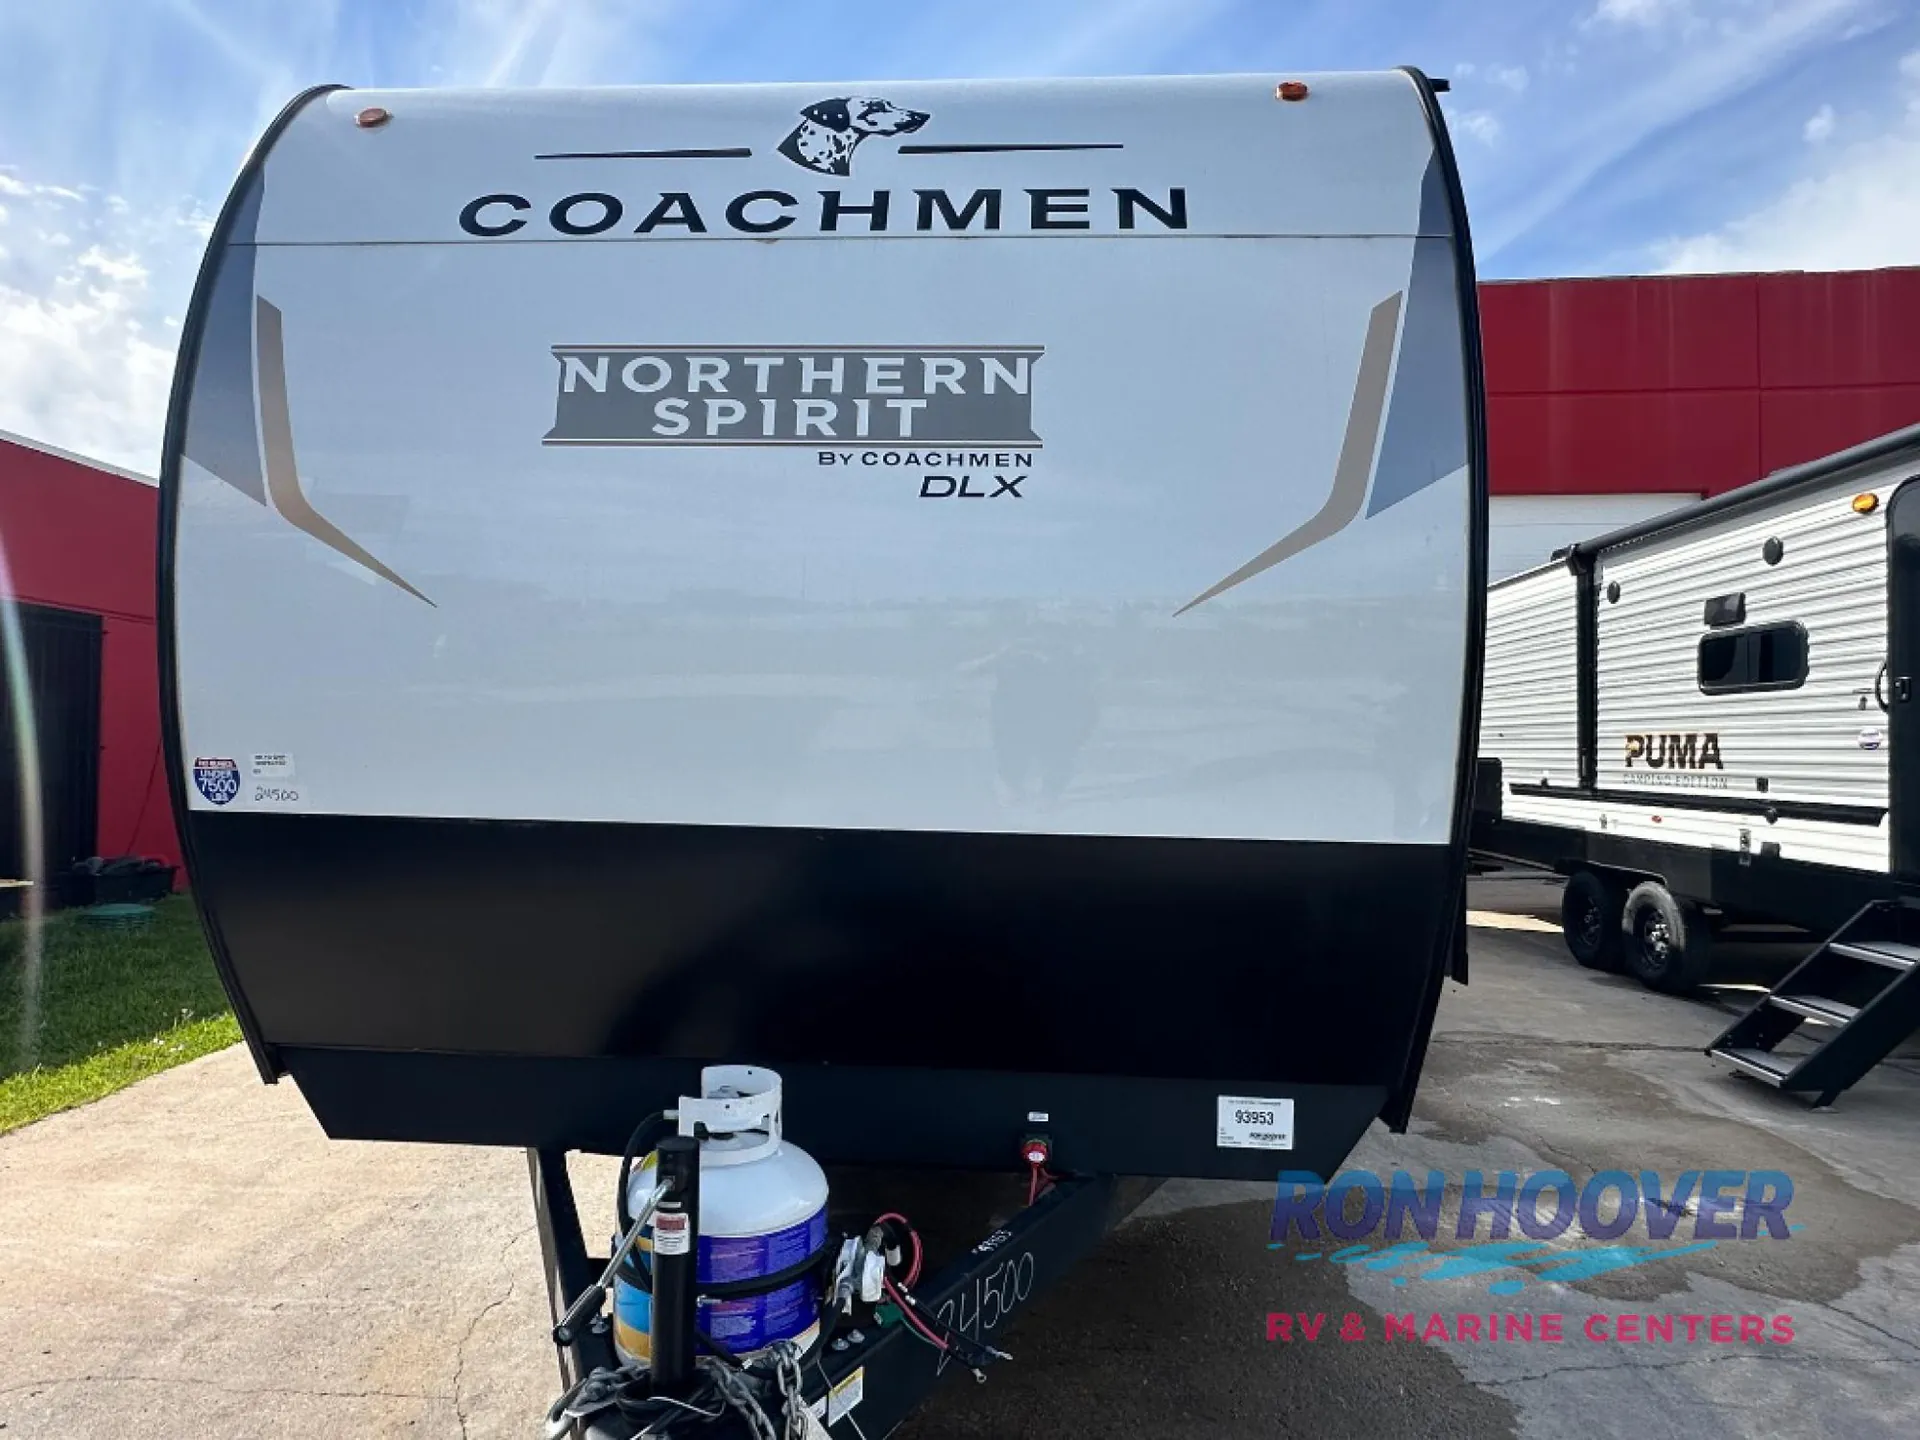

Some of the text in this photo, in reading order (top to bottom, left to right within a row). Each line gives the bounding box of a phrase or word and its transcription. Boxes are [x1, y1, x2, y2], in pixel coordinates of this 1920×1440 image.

[458, 187, 1188, 236] COACHMEN
[562, 356, 1029, 395] NORTHERN
[652, 398, 927, 437] SPIRIT
[818, 451, 1033, 467] BY COACHMEN
[918, 475, 1028, 498] DLX
[1624, 733, 1724, 769] PUMA
[199, 779, 237, 793] 7500
[1235, 1109, 1274, 1125] 93953
